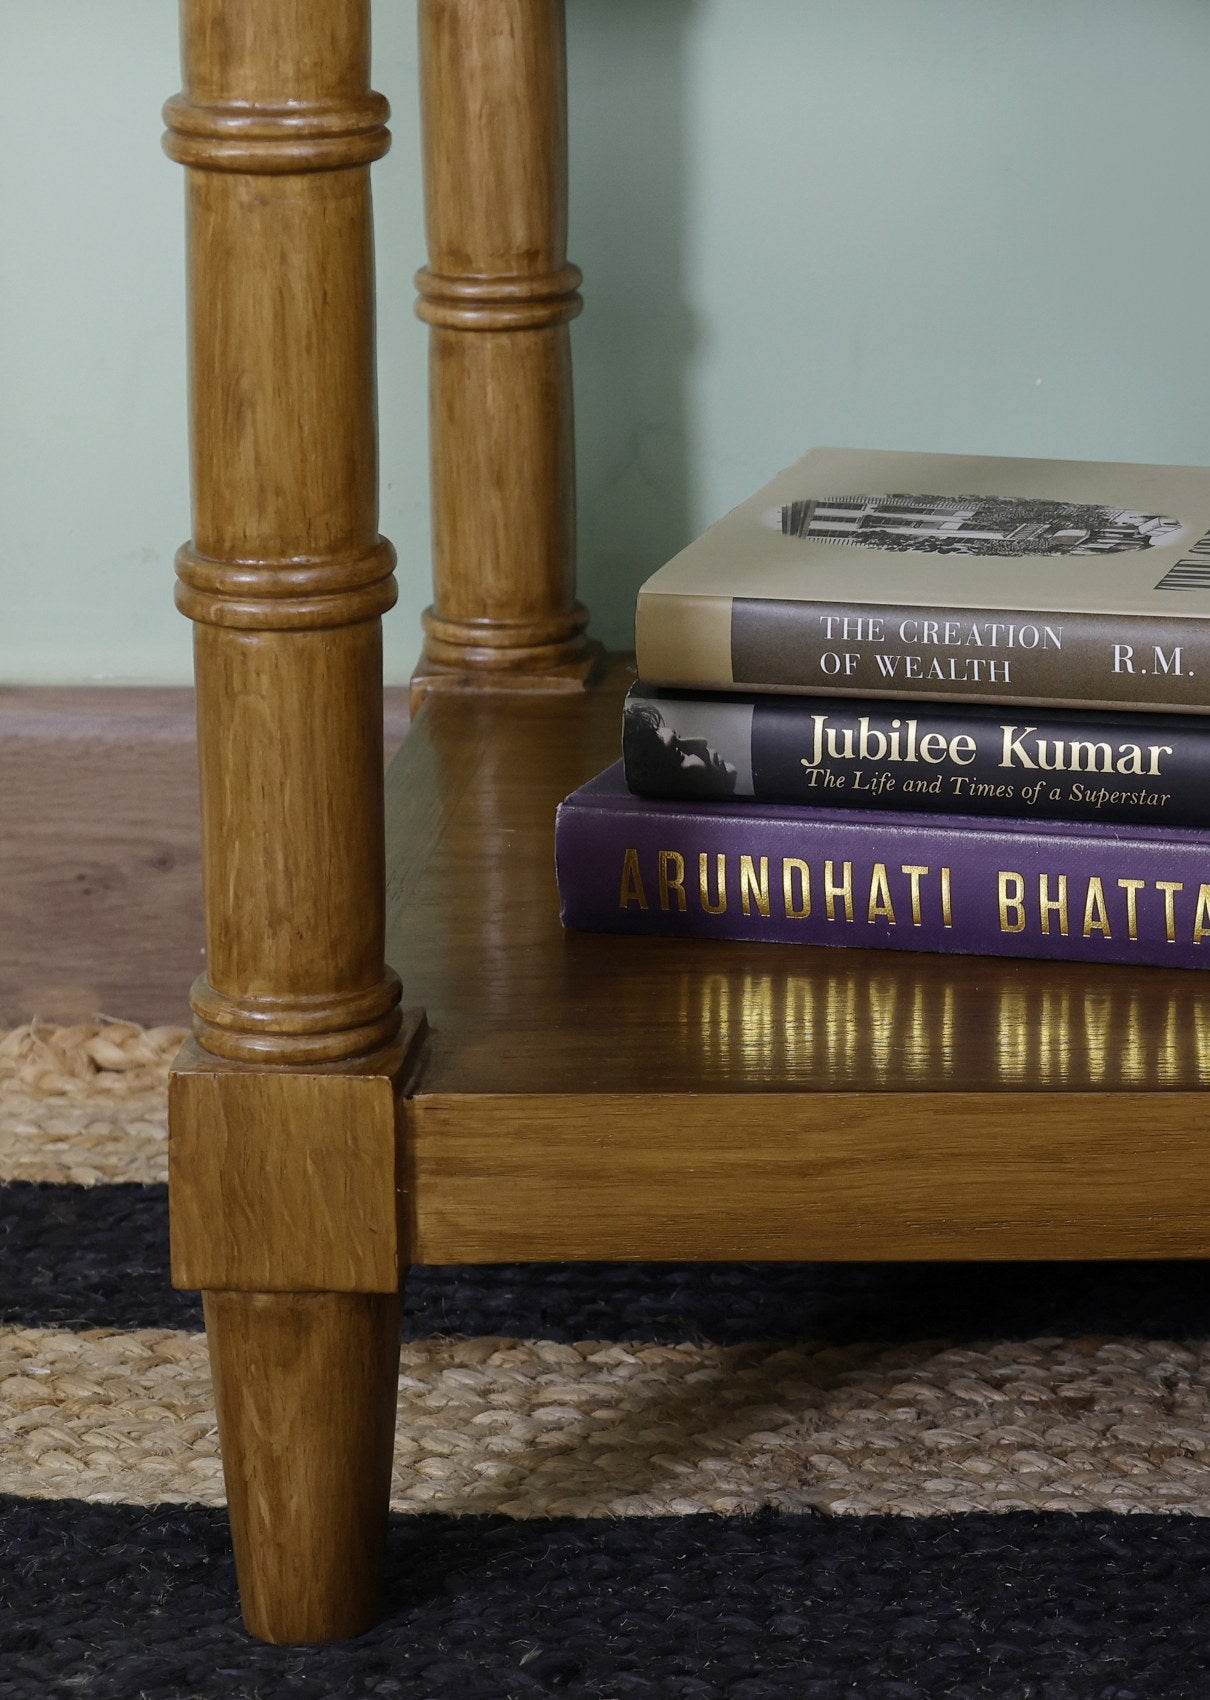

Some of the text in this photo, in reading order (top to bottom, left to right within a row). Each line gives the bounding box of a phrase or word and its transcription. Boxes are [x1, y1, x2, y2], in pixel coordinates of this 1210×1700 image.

[820, 616, 1064, 650] THE CREATION
[819, 652, 1012, 683] OF WEALTH
[1111, 644, 1194, 676] R.M.
[800, 715, 1173, 775] Jubilee Kumar
[806, 769, 1171, 807] The Life and Times of a Superstar
[619, 848, 952, 929] ARUNDHATI
